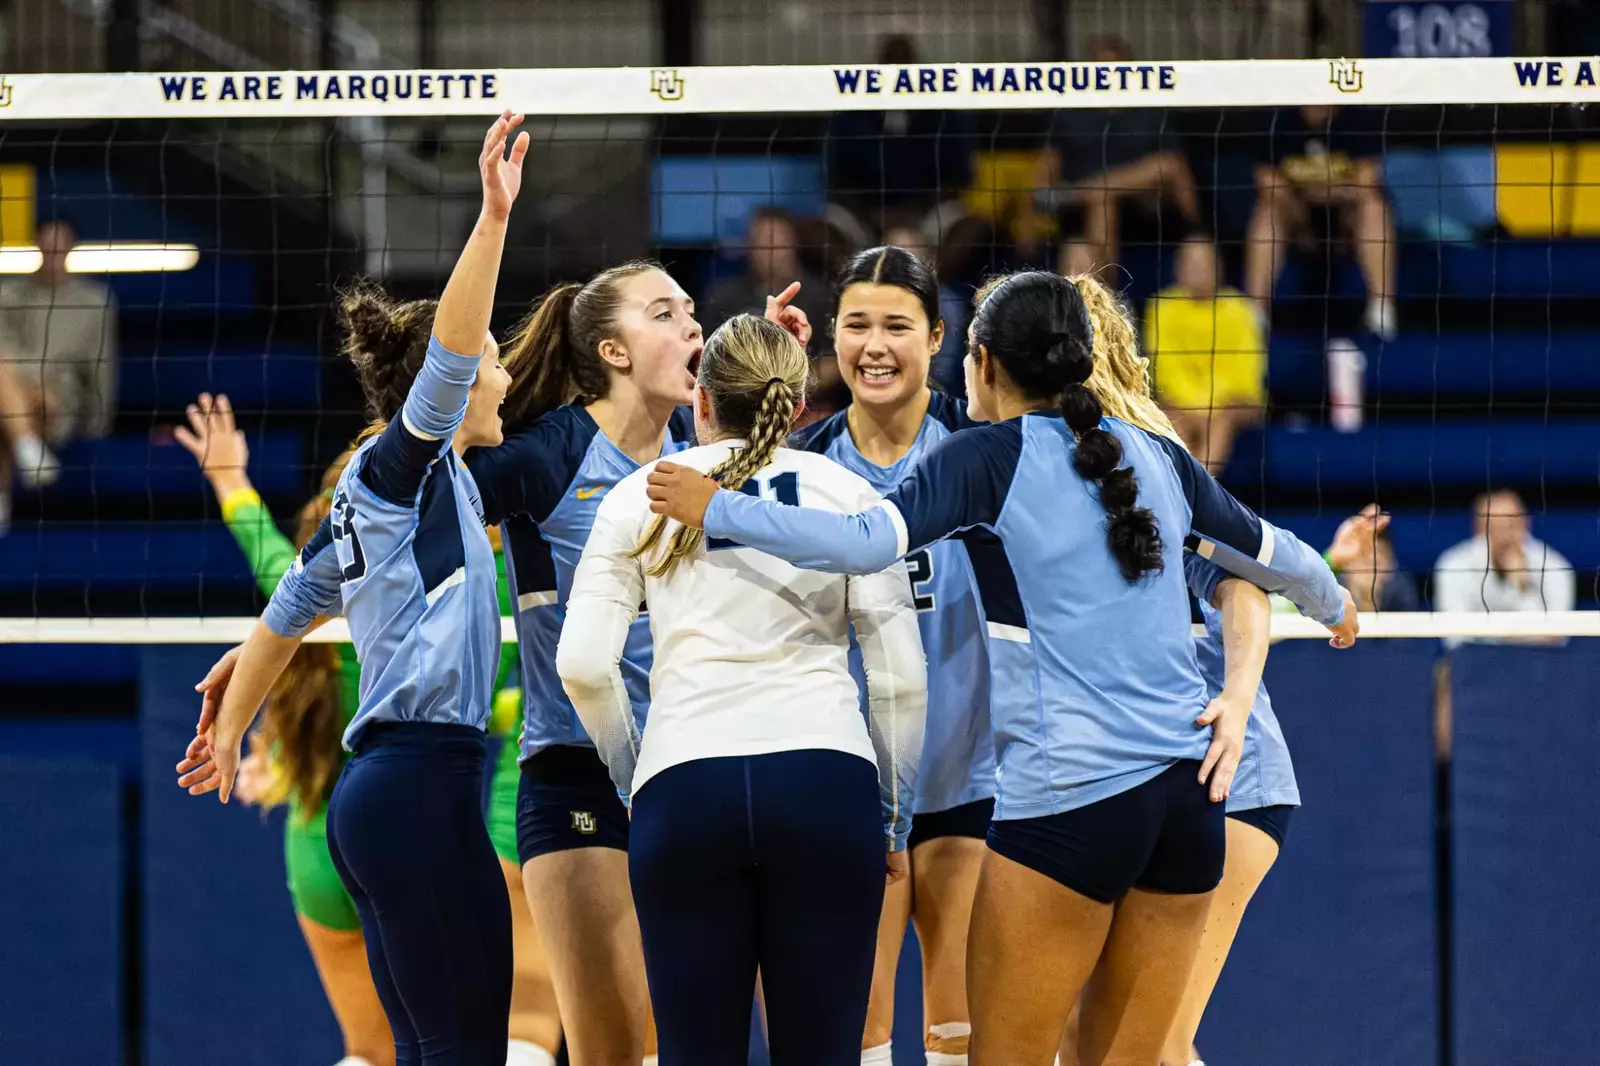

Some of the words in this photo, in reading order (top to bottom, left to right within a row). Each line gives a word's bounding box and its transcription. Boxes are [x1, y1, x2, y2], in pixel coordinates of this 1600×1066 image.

[650, 69, 685, 100] MU
[833, 69, 882, 94] WE
[893, 68, 958, 93] ARE
[971, 65, 1175, 95] MARQUETTE
[1329, 60, 1364, 93] MU
[1513, 60, 1563, 87] WE
[159, 76, 207, 101] WE
[218, 76, 283, 101] ARE
[295, 74, 497, 103] MARQUETTE
[570, 810, 597, 834] MU
